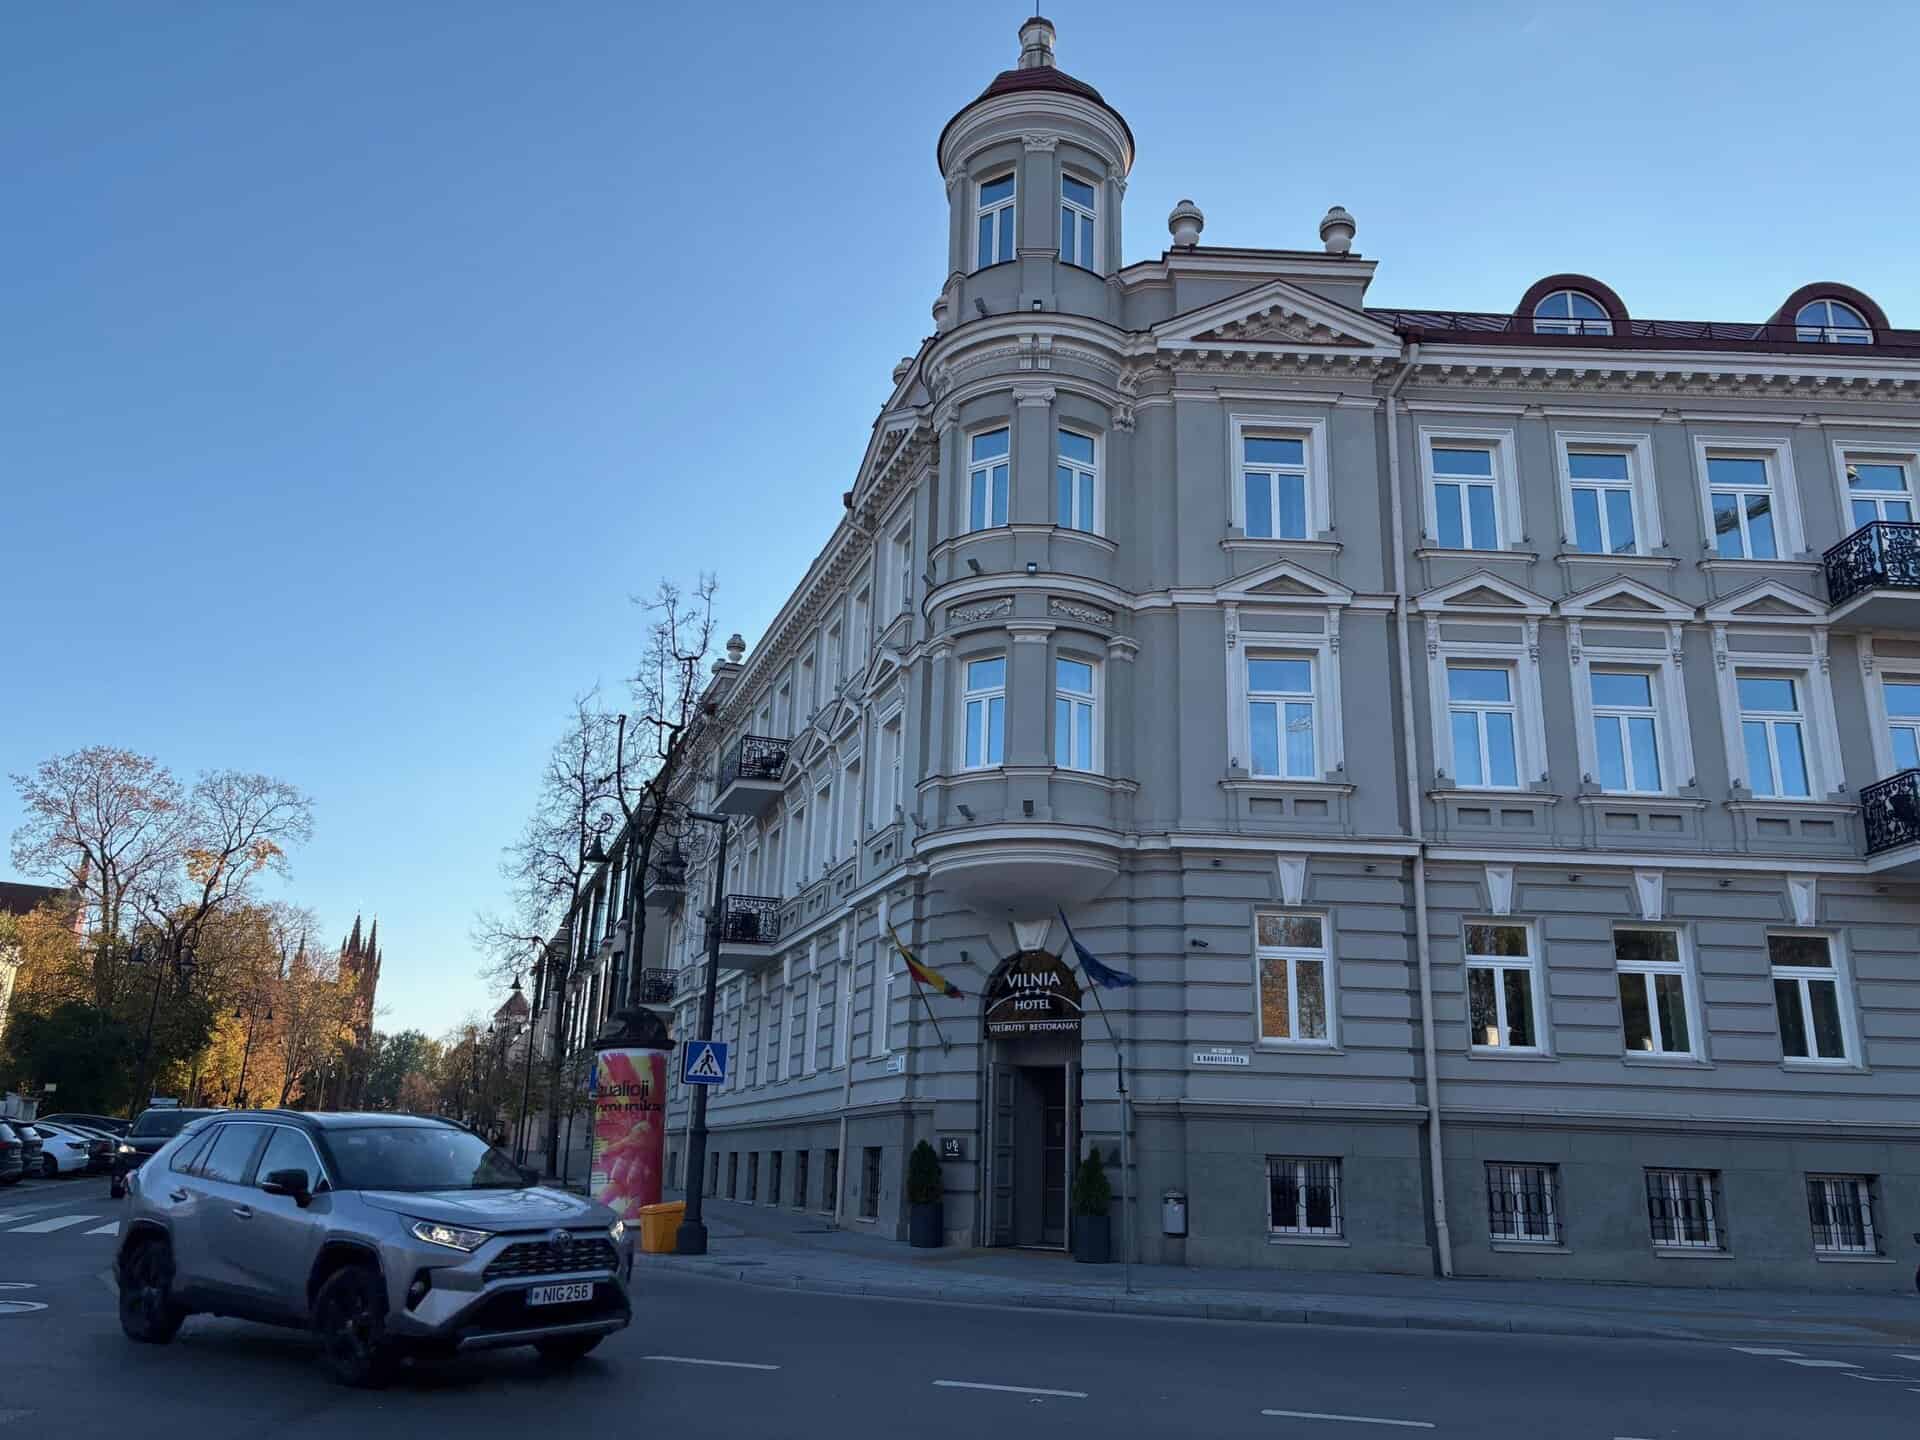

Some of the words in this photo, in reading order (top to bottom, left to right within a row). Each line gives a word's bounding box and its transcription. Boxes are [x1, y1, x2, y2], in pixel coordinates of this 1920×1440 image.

[1006, 971, 1061, 988] VILNIA
[1014, 999, 1051, 1010] HOTEL
[1029, 1022, 1079, 1031] RESTORANAS
